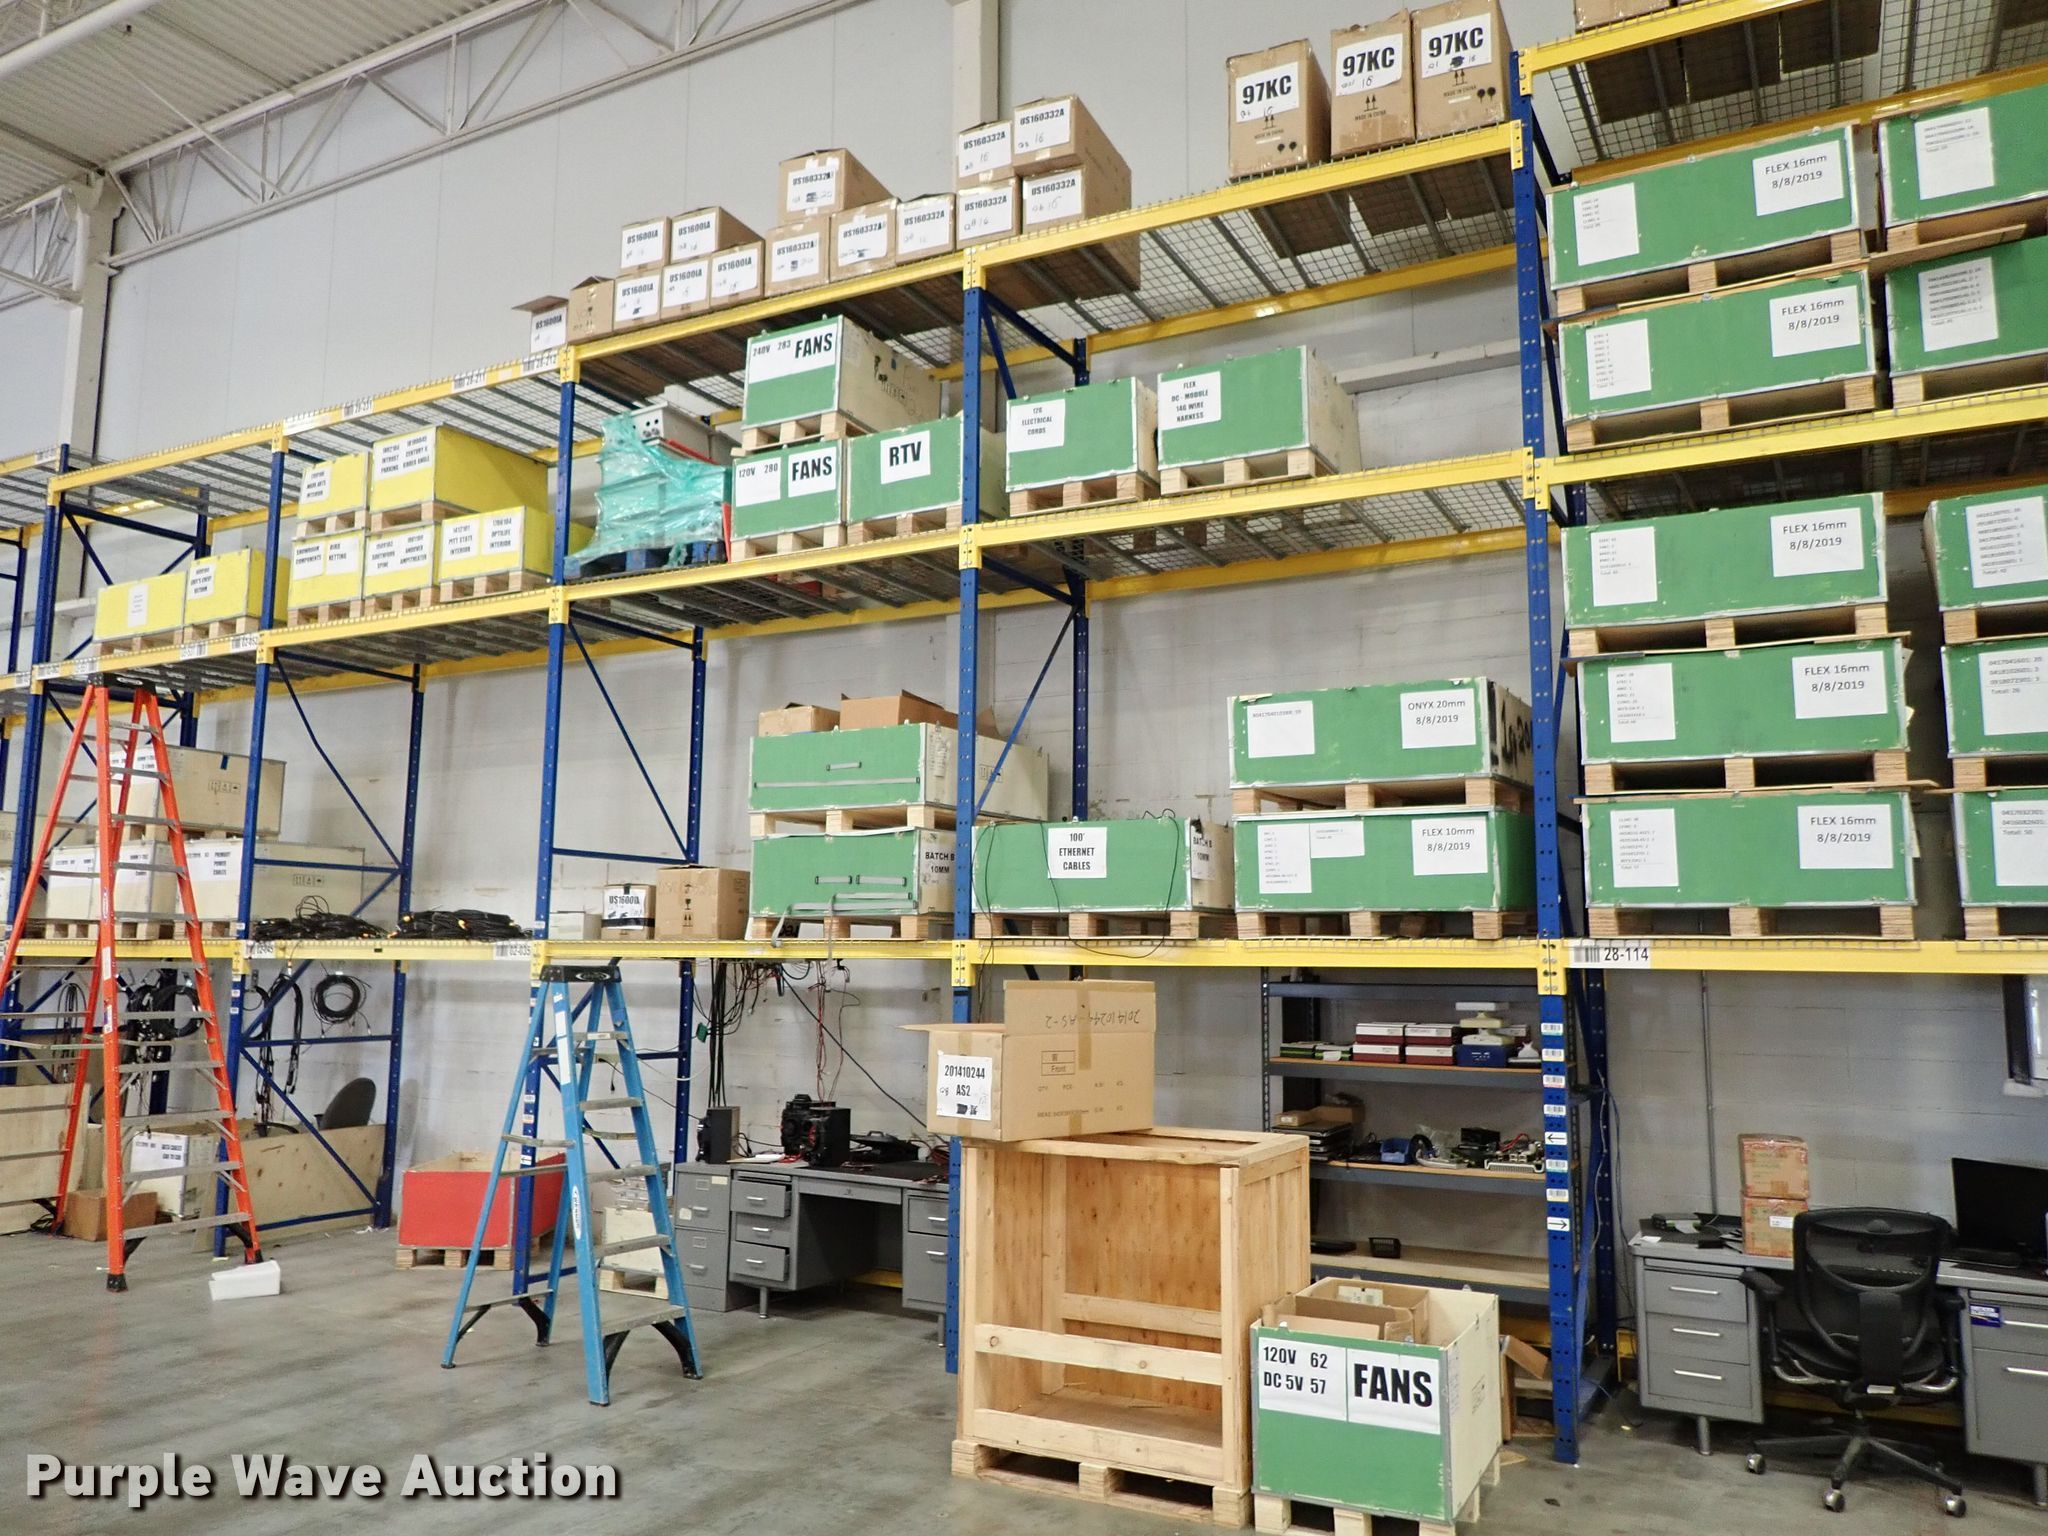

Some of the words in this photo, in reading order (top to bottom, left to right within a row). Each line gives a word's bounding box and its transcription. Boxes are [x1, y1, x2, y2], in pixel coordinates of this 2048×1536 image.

[1428, 26, 1484, 58] 97KC
[1342, 46, 1395, 77] 97KC
[1242, 74, 1292, 105] 97KC
[1020, 107, 1065, 126] US160332A
[963, 130, 1006, 150] US160332A
[1765, 159, 1790, 175] FLEX
[1793, 153, 1828, 171] 16mm
[1031, 178, 1076, 196] US160332A
[1771, 169, 1823, 190] 8/8/2019
[964, 195, 1007, 212] US160332A
[904, 209, 945, 226] US160332A
[1781, 304, 1806, 317] FLEX
[1809, 297, 1845, 312] 16mm
[1787, 314, 1840, 331] 8/8/2019
[795, 333, 833, 358] FANS
[1183, 381, 1196, 389] FLEX
[1171, 394, 1180, 402] DC
[1188, 401, 1204, 410] WIRE
[1021, 416, 1052, 426] ELECTRICAL
[1177, 411, 1204, 422] HARNESS
[1027, 427, 1046, 435] CORDS
[889, 441, 922, 467] RTV
[739, 467, 755, 478] 120V
[764, 462, 778, 473] 280
[792, 456, 833, 482] FANS
[1782, 522, 1808, 534] FLEX
[1811, 518, 1848, 532] 16mm
[1789, 535, 1843, 551] 8/8/2019
[1804, 664, 1830, 676] FLEX
[1833, 662, 1870, 674] 16mm
[1811, 678, 1865, 693] 8/8/2019
[1408, 701, 1434, 711] ONYX
[1436, 698, 1466, 708] 20mm
[1415, 714, 1459, 726] 8/8/2019
[1810, 815, 1836, 827] FLEX
[1840, 814, 1877, 826] 16mm
[1422, 828, 1443, 837] FLEX
[1445, 826, 1475, 836] 10mm
[1816, 830, 1872, 845] 8/8/2019
[1058, 847, 1095, 857] ETHERNET
[1427, 841, 1471, 853] 8/8/2019
[925, 851, 949, 861] BATCH
[931, 865, 950, 874] 10MM
[1063, 861, 1091, 871] CABLES
[1604, 947, 1649, 961] 28-114
[944, 1065, 985, 1079] 201410244
[956, 1084, 971, 1096] AS2
[1263, 1346, 1297, 1365] 120V
[1310, 1352, 1328, 1369] 62
[1263, 1371, 1282, 1388] DC
[1286, 1376, 1303, 1391] 5V
[1310, 1378, 1326, 1395] 57
[1354, 1363, 1433, 1408] FANS
